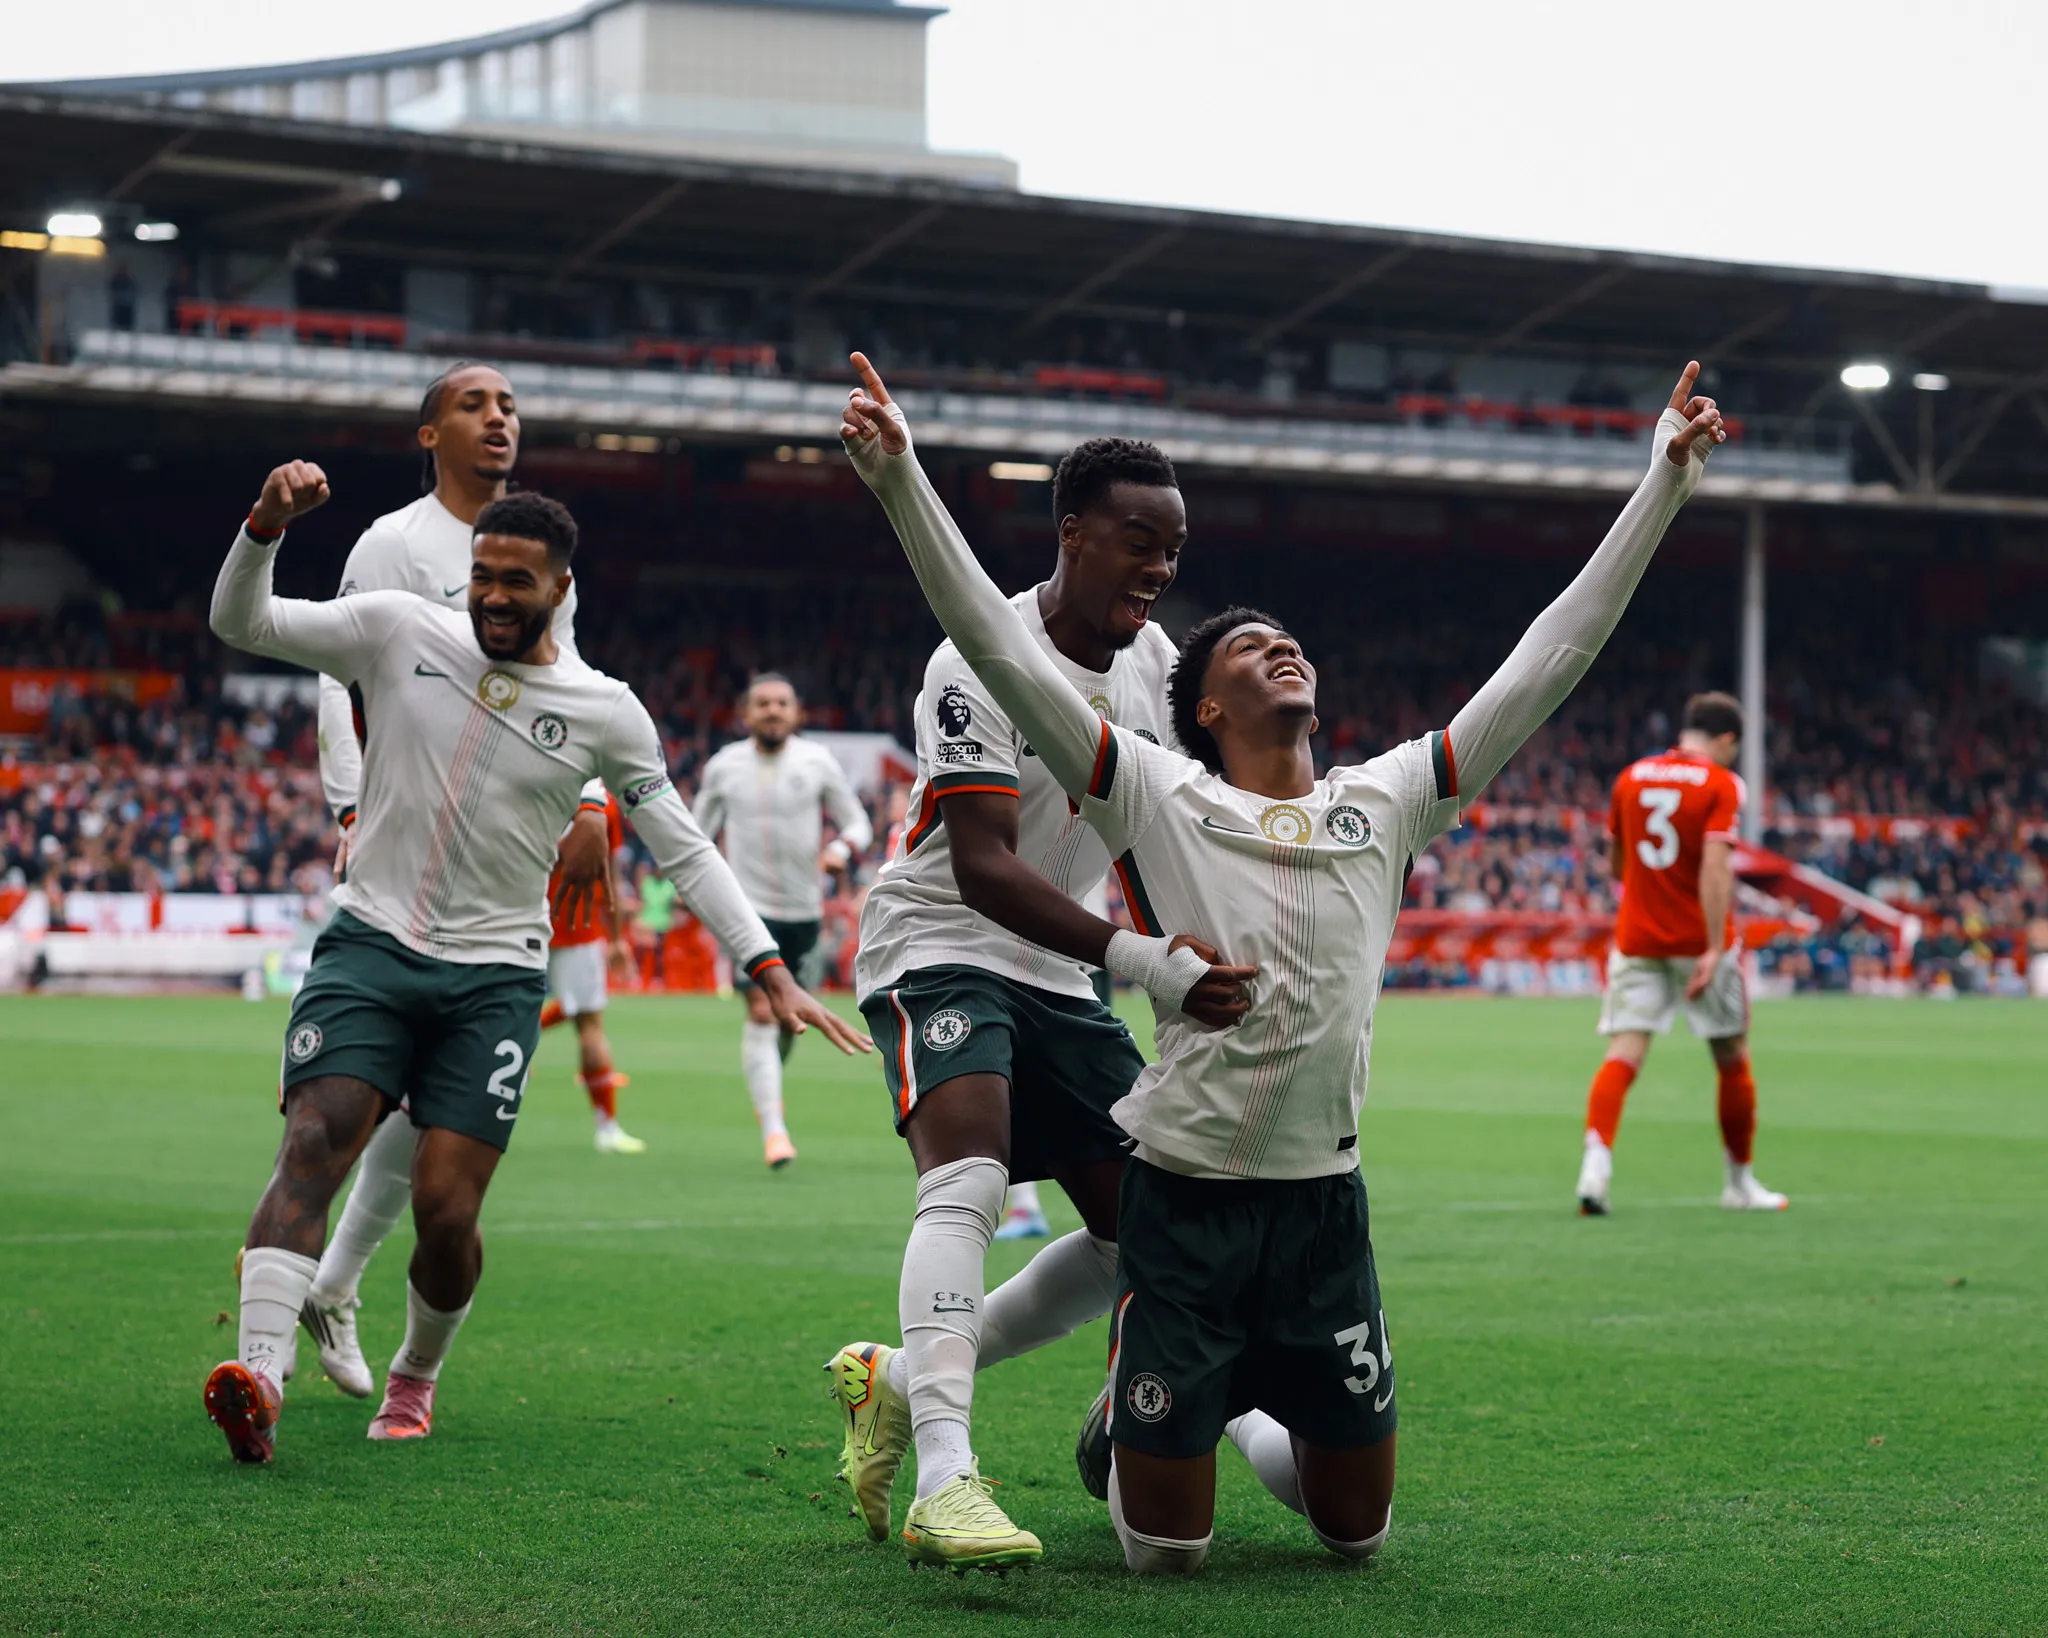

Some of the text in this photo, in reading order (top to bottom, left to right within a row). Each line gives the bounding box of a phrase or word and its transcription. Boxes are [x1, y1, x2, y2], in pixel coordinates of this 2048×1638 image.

[937, 744, 948, 754] No
[949, 753, 983, 762] racism
[1328, 806, 1355, 822] CHELSEA
[1264, 808, 1308, 836] WORLD CHAMPIONS
[1636, 787, 1682, 870] 3
[930, 1011, 960, 1024] CHELSEA
[487, 1039, 529, 1101] 2
[1137, 1374, 1164, 1388] CHELSEA
